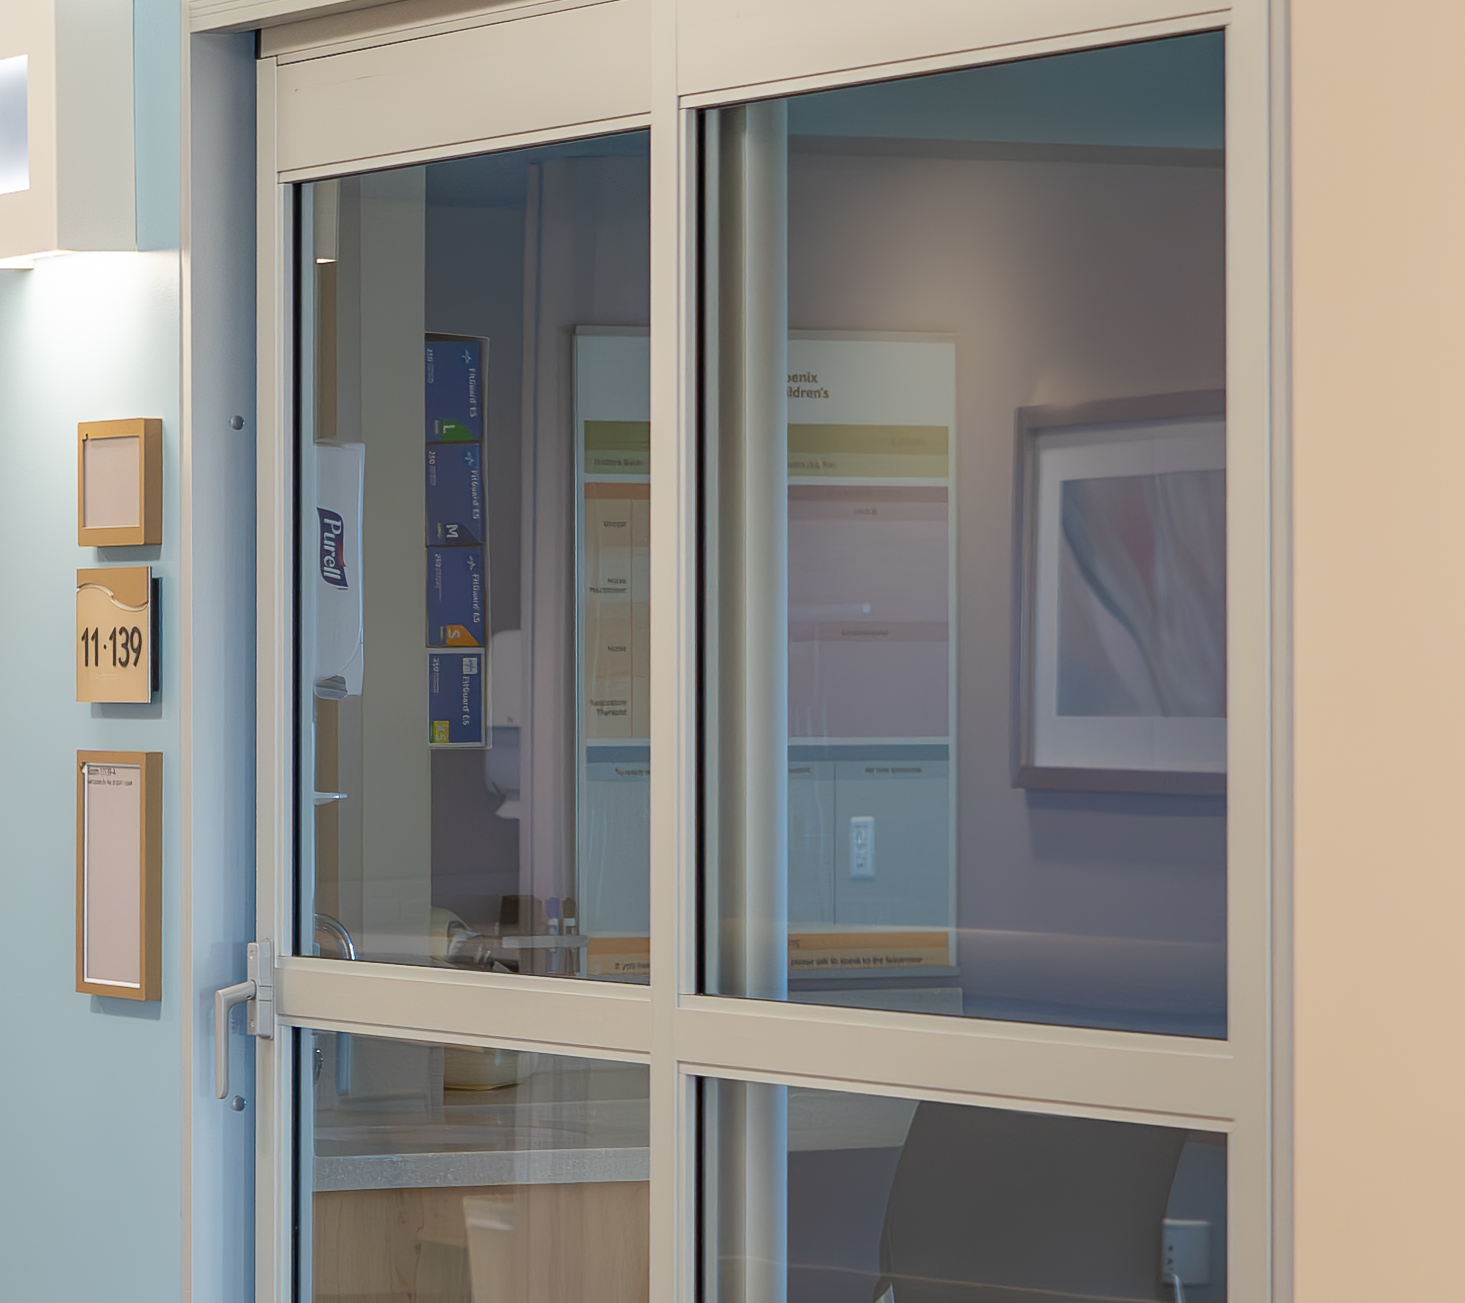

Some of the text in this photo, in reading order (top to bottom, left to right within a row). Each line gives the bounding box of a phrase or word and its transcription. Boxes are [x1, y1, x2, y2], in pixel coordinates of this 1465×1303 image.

[787, 385, 830, 398] ldren's
[442, 423, 456, 434] L
[446, 524, 459, 539] M
[323, 517, 343, 580] Purell
[448, 629, 460, 640] S
